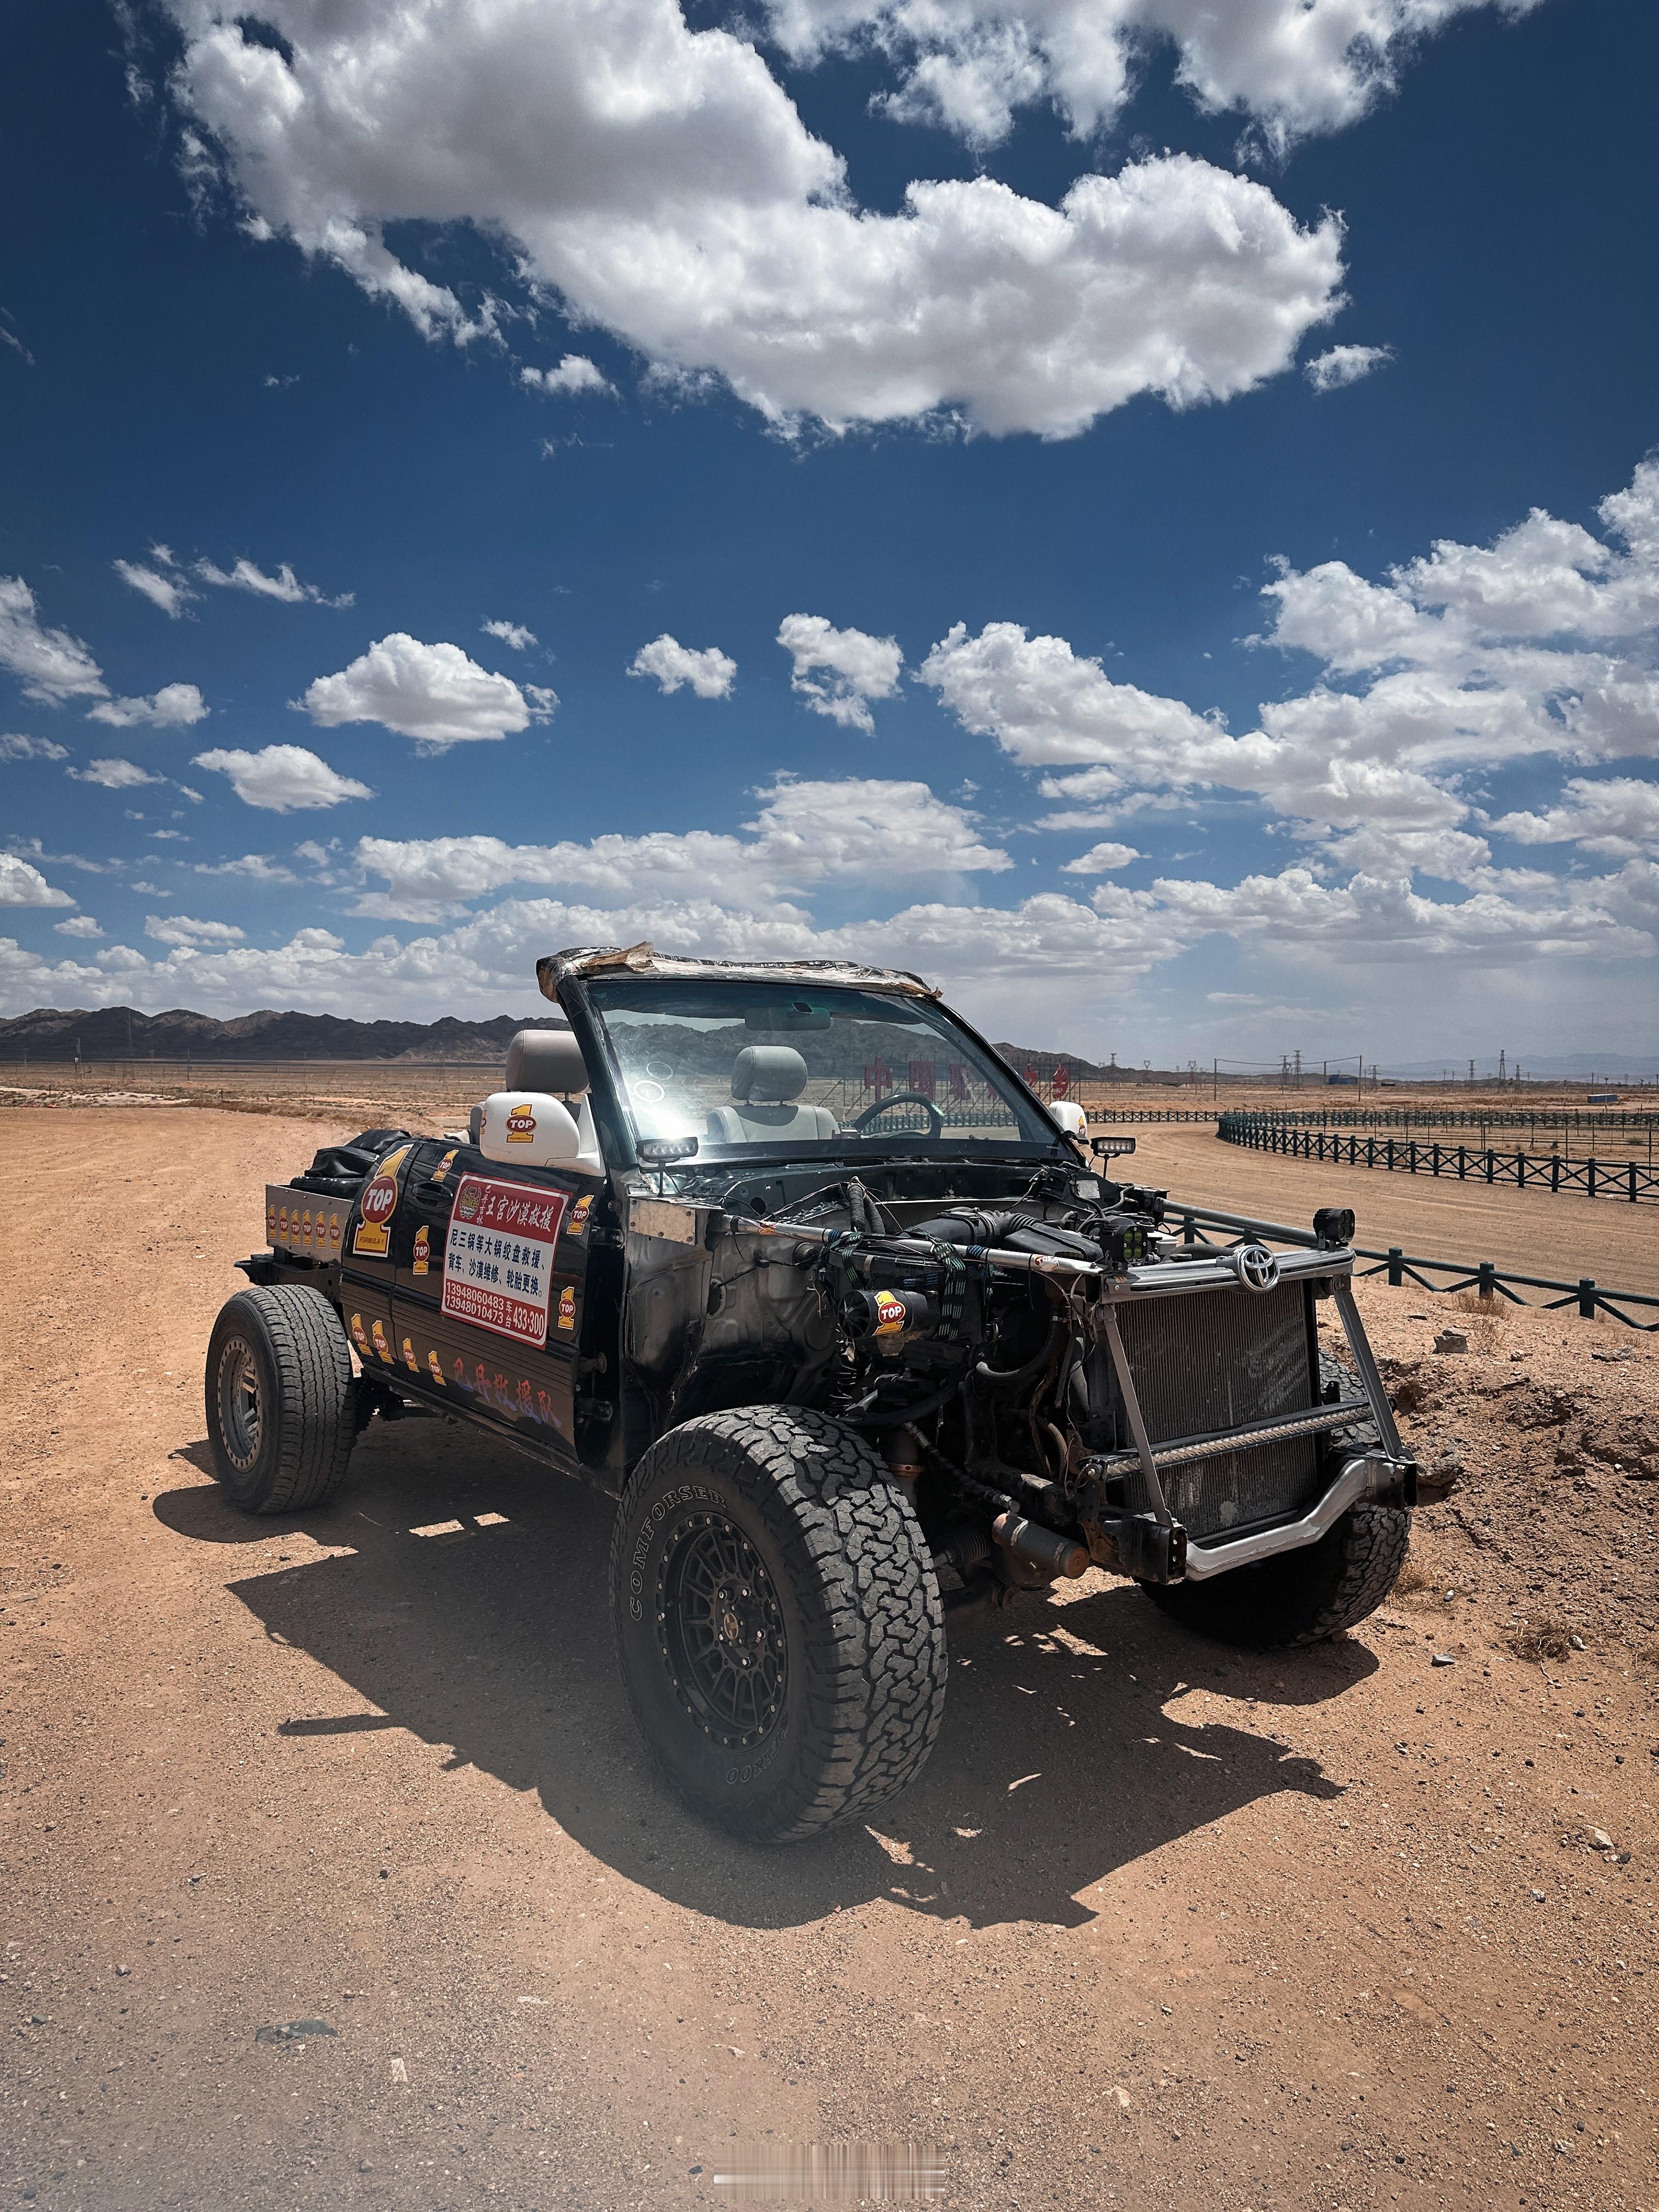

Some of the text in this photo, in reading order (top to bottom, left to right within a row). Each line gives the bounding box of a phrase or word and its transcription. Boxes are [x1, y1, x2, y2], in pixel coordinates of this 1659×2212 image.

[510, 1119, 534, 1128] TOP
[439, 1161, 450, 1170] TOP
[365, 1188, 393, 1212] TOP
[476, 1184, 492, 1226] 巴丹吉林
[573, 1210, 587, 1219] TOP
[317, 1226, 325, 1234] TOP
[331, 1228, 339, 1237] TOP
[415, 1246, 427, 1256] TOP
[447, 1282, 504, 1310] 13948060483
[446, 1295, 504, 1324] 13948010473
[561, 1303, 573, 1314] TOP
[881, 1305, 902, 1320] TOP
[505, 1300, 512, 1328] 车台
[354, 1331, 365, 1341] TOP
[375, 1338, 386, 1348] TOP
[431, 1364, 441, 1373] TOP
[630, 1486, 727, 1621] COMFORSER
